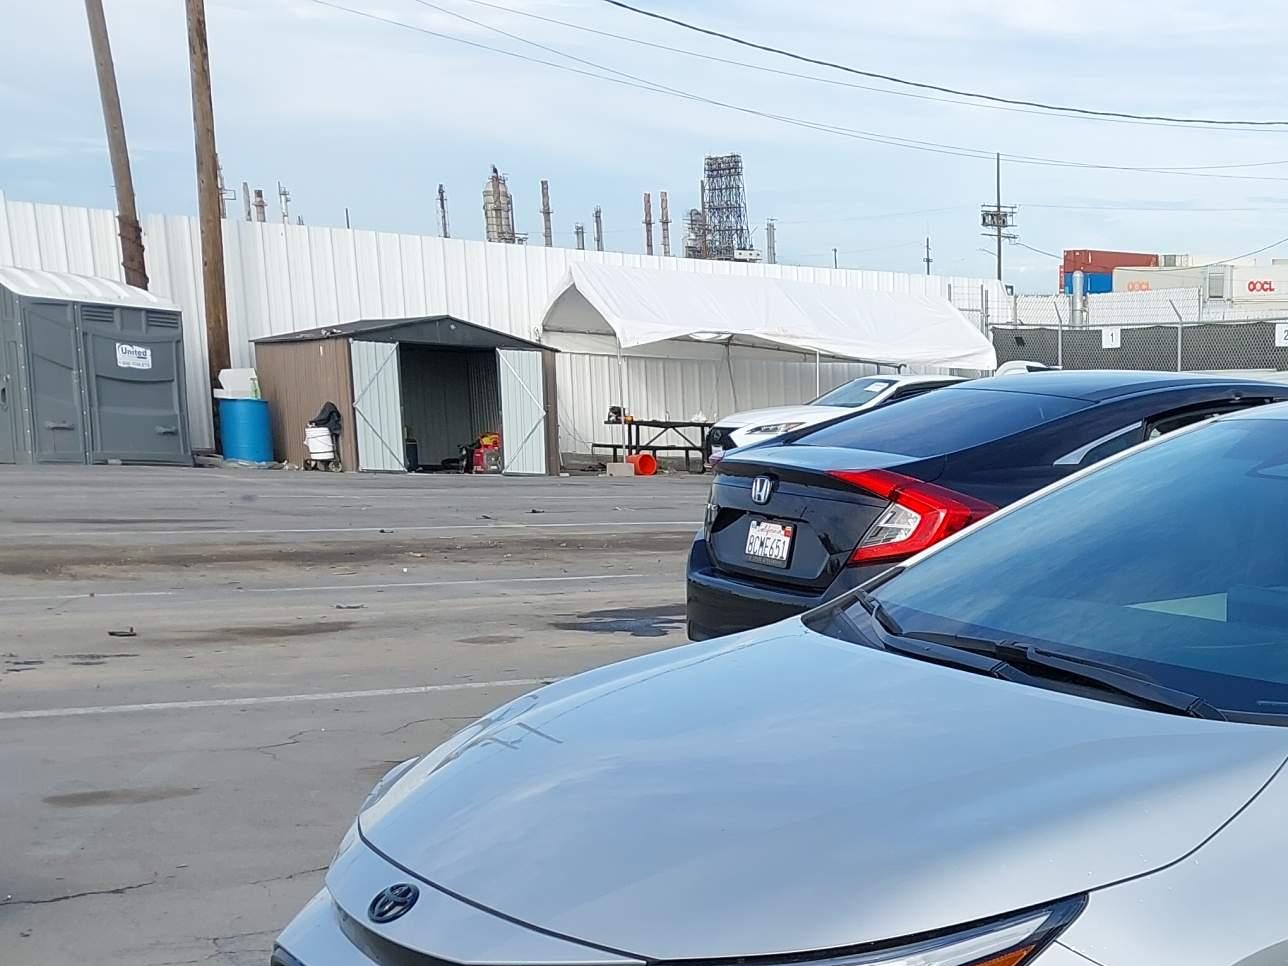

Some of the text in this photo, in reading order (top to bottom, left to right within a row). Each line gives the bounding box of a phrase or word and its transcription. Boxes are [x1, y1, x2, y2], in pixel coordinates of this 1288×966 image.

[1248, 280, 1275, 292] OOCL
[1283, 329, 1288, 341] 2
[121, 346, 147, 356] United
